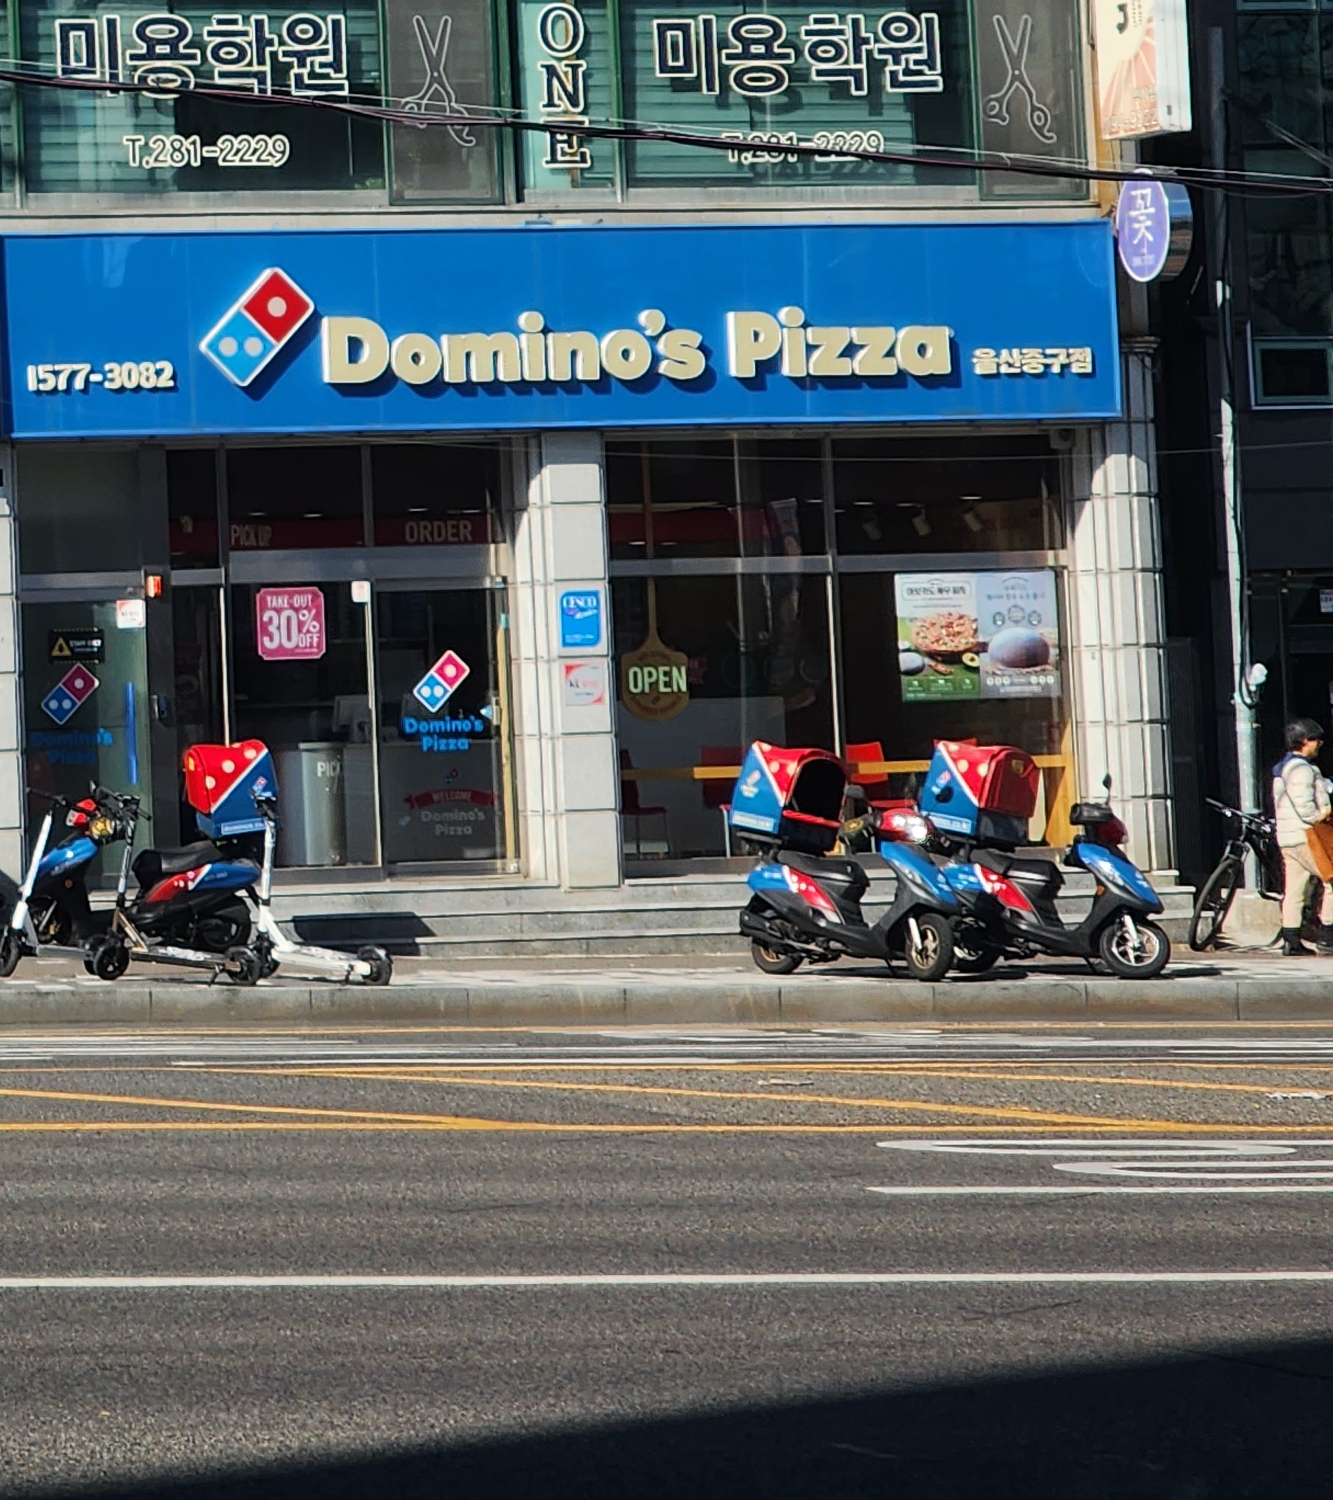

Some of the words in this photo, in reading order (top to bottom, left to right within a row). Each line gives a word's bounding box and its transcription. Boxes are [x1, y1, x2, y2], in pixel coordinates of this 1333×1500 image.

[53, 11, 351, 100] 미용학원
[651, 10, 945, 97] 미용학원
[536, 0, 591, 170] ONE
[122, 133, 291, 168] T.281-2229
[321, 308, 708, 388] Domino's
[727, 305, 954, 382] Pizza
[972, 346, 1093, 375] 울산중구점
[26, 360, 176, 392] 1577-3082
[404, 519, 474, 544] ORDER
[265, 594, 313, 609] TAKE-OUT
[298, 632, 321, 649] OFF
[628, 665, 688, 694] OPEN
[403, 714, 485, 734] Domino's
[421, 735, 470, 753] Pizza
